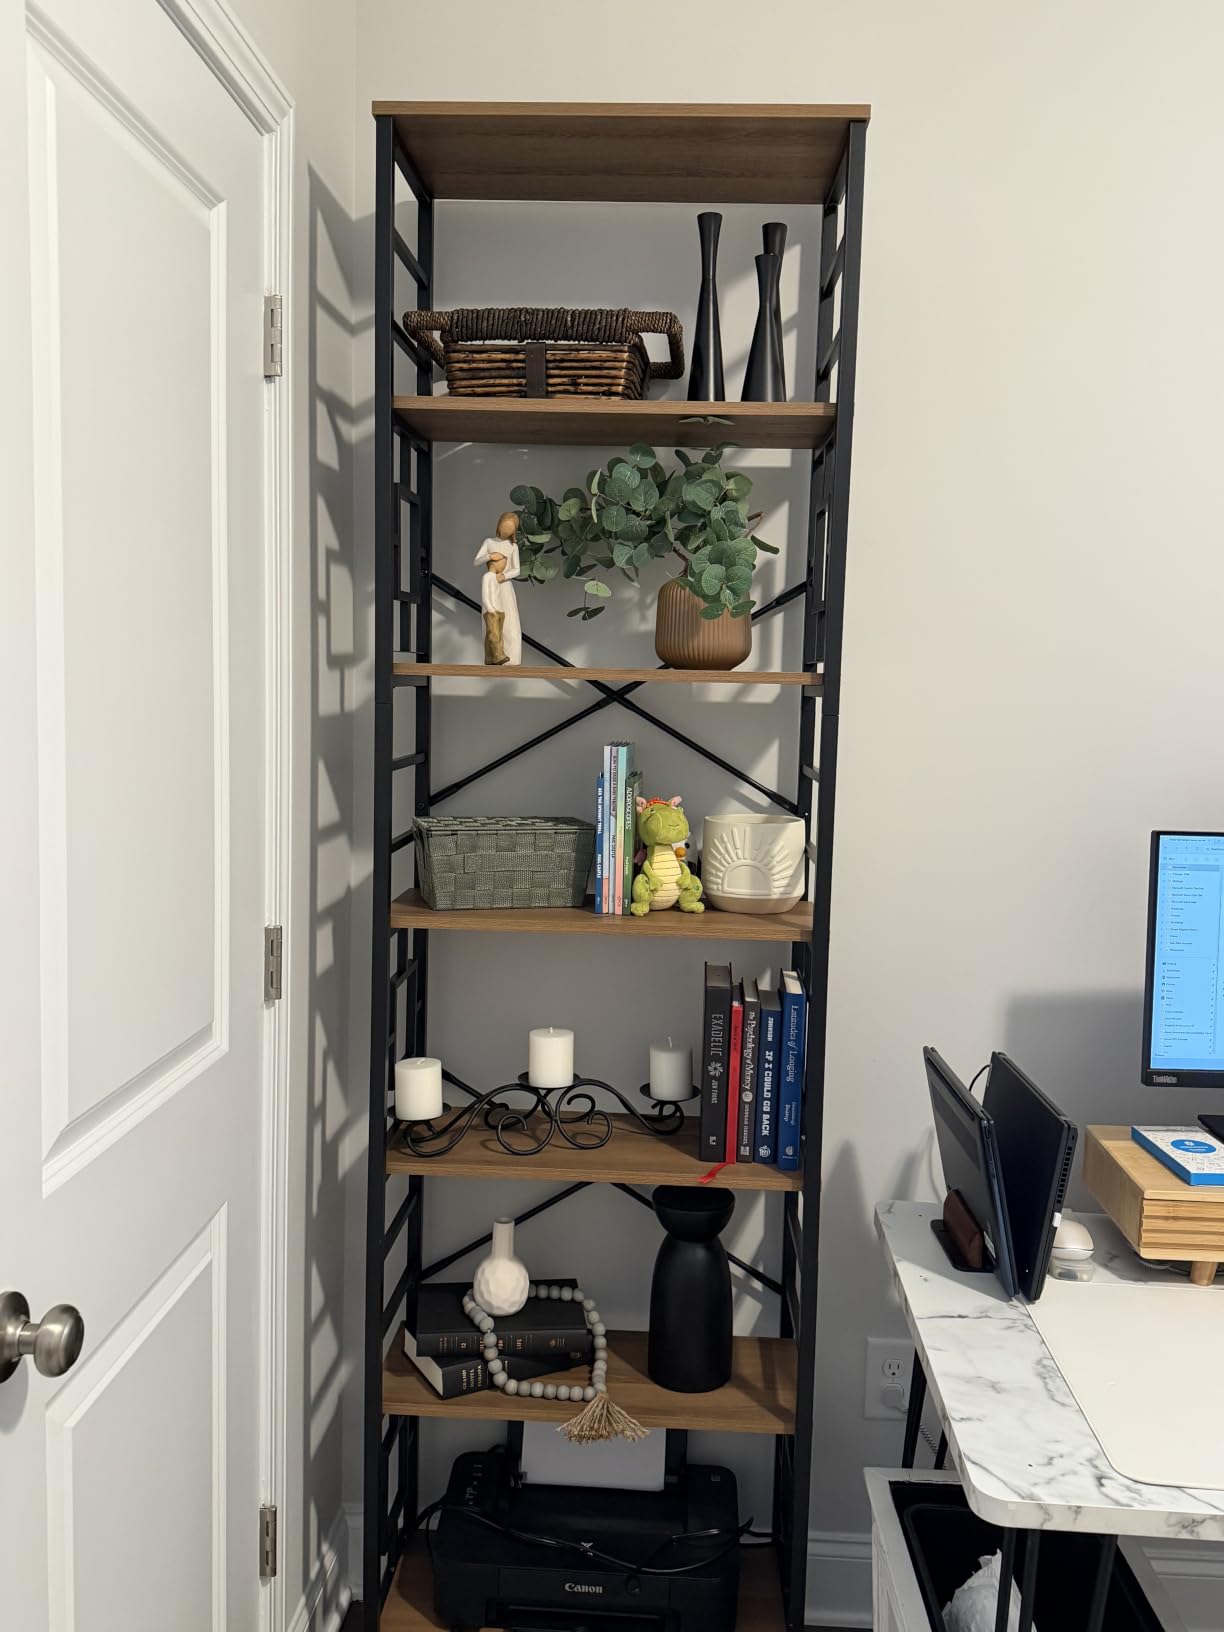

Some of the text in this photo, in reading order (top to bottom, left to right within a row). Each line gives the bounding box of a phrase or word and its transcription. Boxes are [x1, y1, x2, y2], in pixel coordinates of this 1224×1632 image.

[710, 1014, 724, 1056] EXADELIC
[744, 1020, 755, 1059] Psychology
[786, 1005, 799, 1083] Latitudes of Longing
[765, 1050, 773, 1061] IF
[743, 1065, 754, 1090] Money
[764, 1071, 772, 1098] COULD
[763, 1100, 771, 1112] GO
[762, 1114, 770, 1136] BACK
[564, 1582, 603, 1594] Canon
